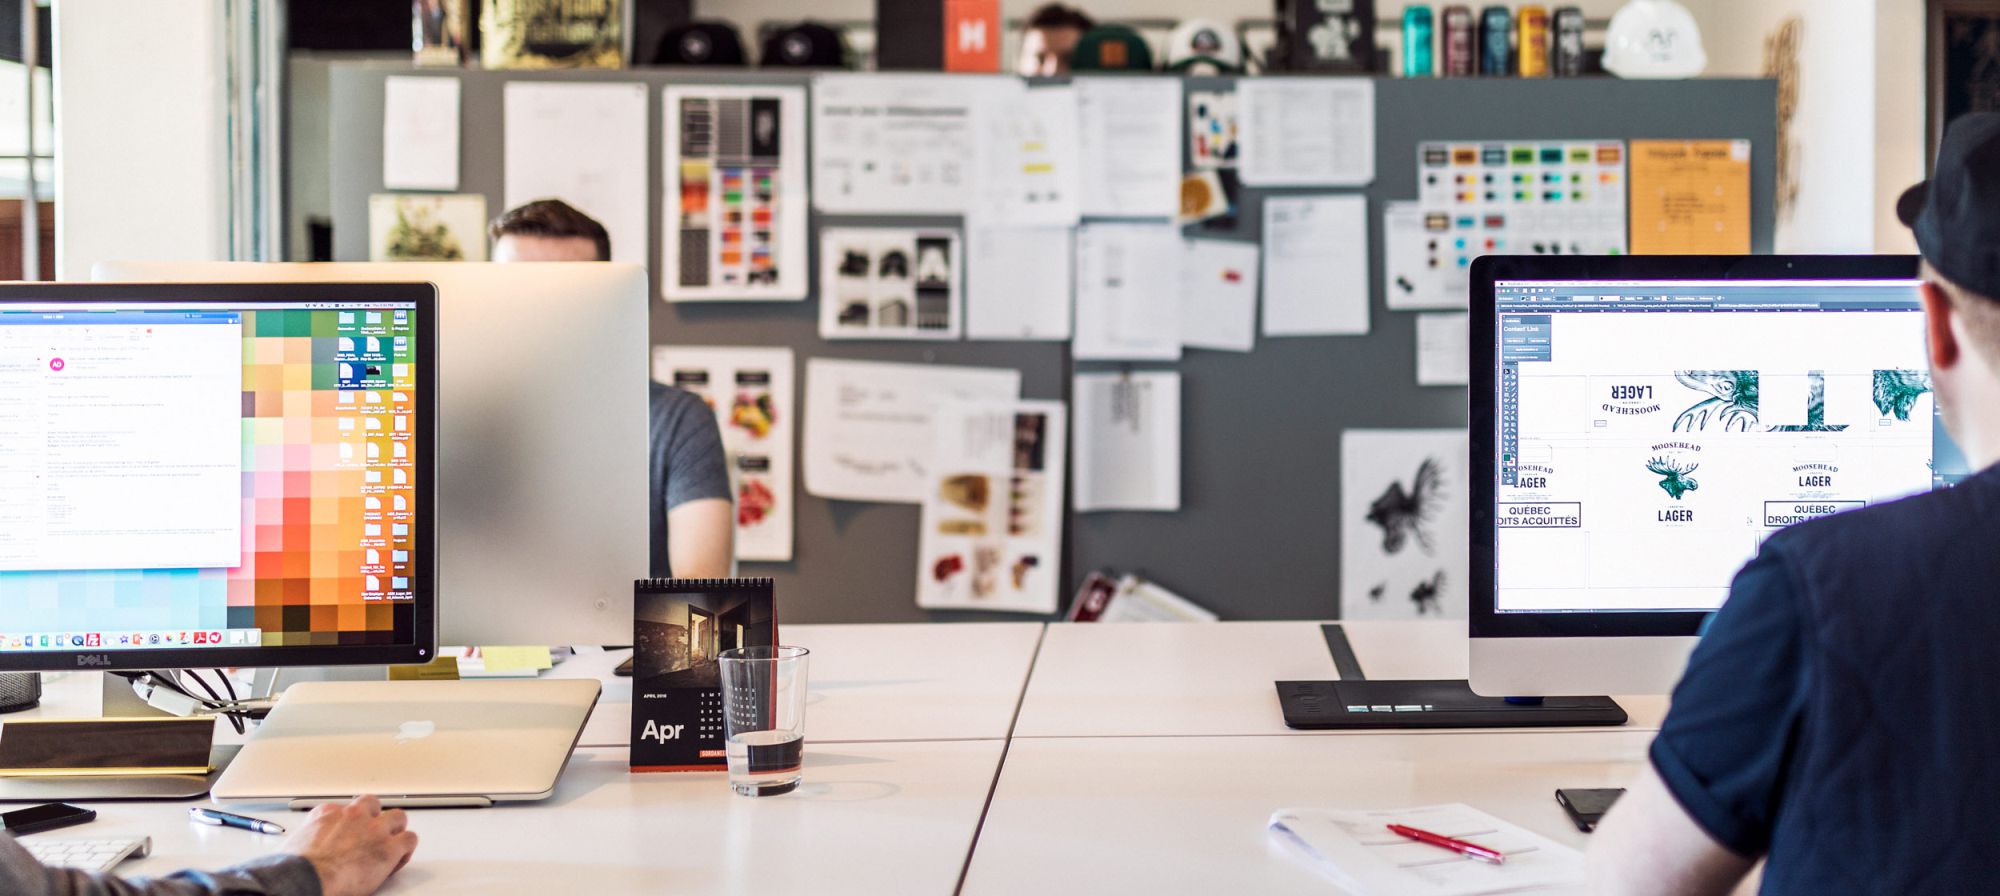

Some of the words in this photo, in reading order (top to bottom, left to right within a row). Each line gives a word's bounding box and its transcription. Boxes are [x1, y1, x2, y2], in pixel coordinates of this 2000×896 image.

[958, 19, 986, 54] H
[1611, 385, 1652, 399] LAGER
[1602, 403, 1661, 415] MOOSEHEAD
[1651, 441, 1701, 452] MOOSEHEAD
[1518, 464, 1554, 474] OSEHEAD
[1792, 463, 1839, 472] MOOSEHEAD
[1799, 476, 1831, 487] LAGER
[1509, 504, 1551, 515] QUÉBEC
[1794, 503, 1836, 514] QUÉBEC
[1522, 514, 1578, 525] ACQUITTÉS
[1658, 509, 1693, 521] LAGER
[77, 654, 111, 666] DELL
[641, 719, 684, 744] Apr
